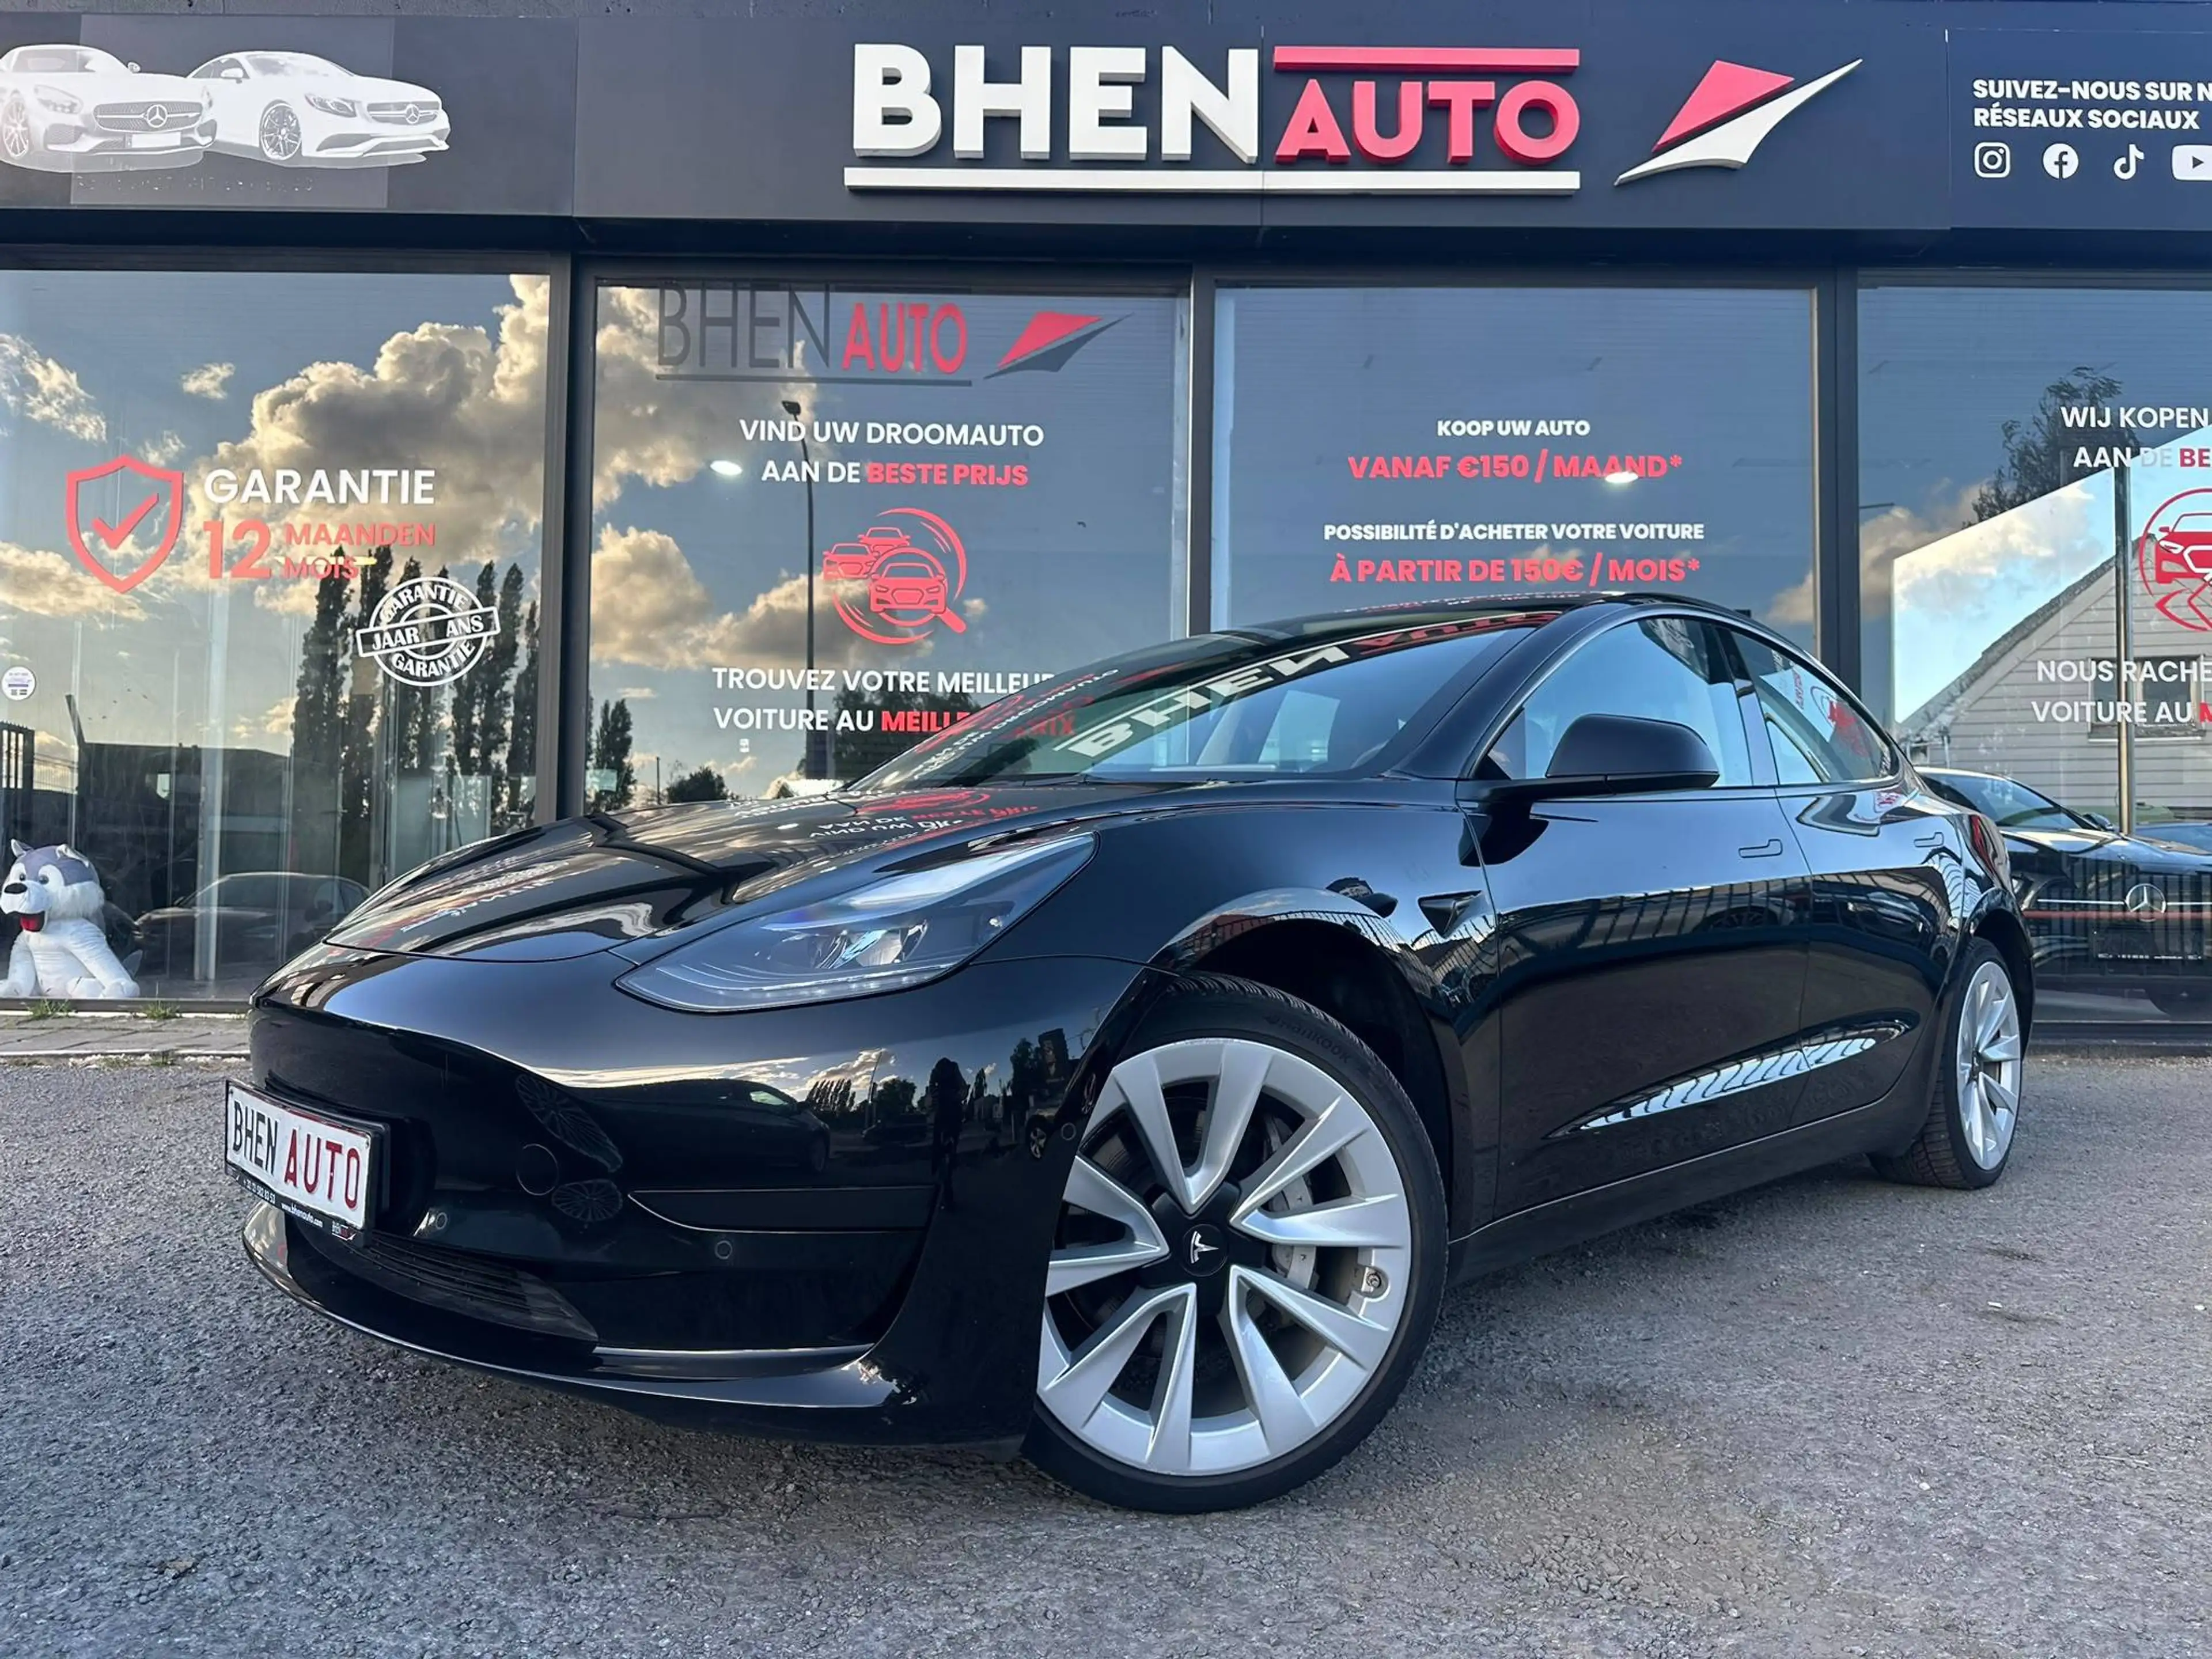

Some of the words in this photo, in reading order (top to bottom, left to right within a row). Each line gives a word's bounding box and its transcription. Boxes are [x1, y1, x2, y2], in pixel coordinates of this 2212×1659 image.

[1973, 79, 2141, 100] SUIVEZ-NOUS
[2145, 81, 2192, 101] SUR
[853, 44, 1259, 164] BHEN
[1275, 79, 1580, 165] AUTO
[1974, 102, 2084, 127] RÉSEAUX
[2088, 109, 2200, 129] SOCIAUX
[658, 279, 831, 369] BHEN
[842, 302, 968, 374] AUTO
[1437, 421, 1495, 436] KOOP
[1497, 421, 1533, 436] UW
[1535, 421, 1590, 436] AUTO
[2060, 406, 2110, 428] WIJ
[2120, 406, 2209, 429] KOPEN
[739, 419, 806, 441] VIND
[813, 422, 859, 443] UW
[866, 423, 1044, 447] DROOMAUTO
[1348, 456, 1451, 478] VANAF
[1457, 455, 1528, 479] €150
[1534, 449, 1549, 483] /
[2073, 446, 2131, 468] AAN
[2140, 447, 2173, 467] DE
[204, 468, 435, 504] GARANTIE
[761, 460, 819, 482] AAN
[828, 462, 861, 483] DE
[867, 463, 948, 486] BESTE
[954, 464, 1028, 486] PRIJS
[1324, 520, 1437, 540] POSSIBILITÉ
[1442, 522, 1547, 540] D'ACHETER
[1552, 523, 1616, 540] VOTRE
[1619, 523, 1704, 540] VOITURE
[203, 519, 272, 579] 12
[286, 522, 436, 547] MAANDEN
[283, 555, 361, 579] MOIS
[1329, 553, 1351, 582] À
[1357, 560, 1461, 582] PARTIR
[1469, 559, 1504, 582] DE
[1510, 559, 1584, 582] 150€
[1588, 552, 1603, 587] /
[379, 584, 469, 622] GARANTIE
[372, 627, 421, 650] JAAR
[446, 615, 484, 637] ANS
[391, 639, 476, 677] GARANTIE
[2037, 660, 2114, 682] NOUS
[712, 667, 835, 690] TROUVEZ
[842, 669, 929, 692] VOTRE
[713, 707, 828, 731] VOITURE
[835, 709, 874, 732] AU
[2031, 700, 2147, 723] VOITURE
[2154, 702, 2191, 723] AU
[233, 1100, 278, 1176] BHEN
[284, 1128, 361, 1209] AUTO
